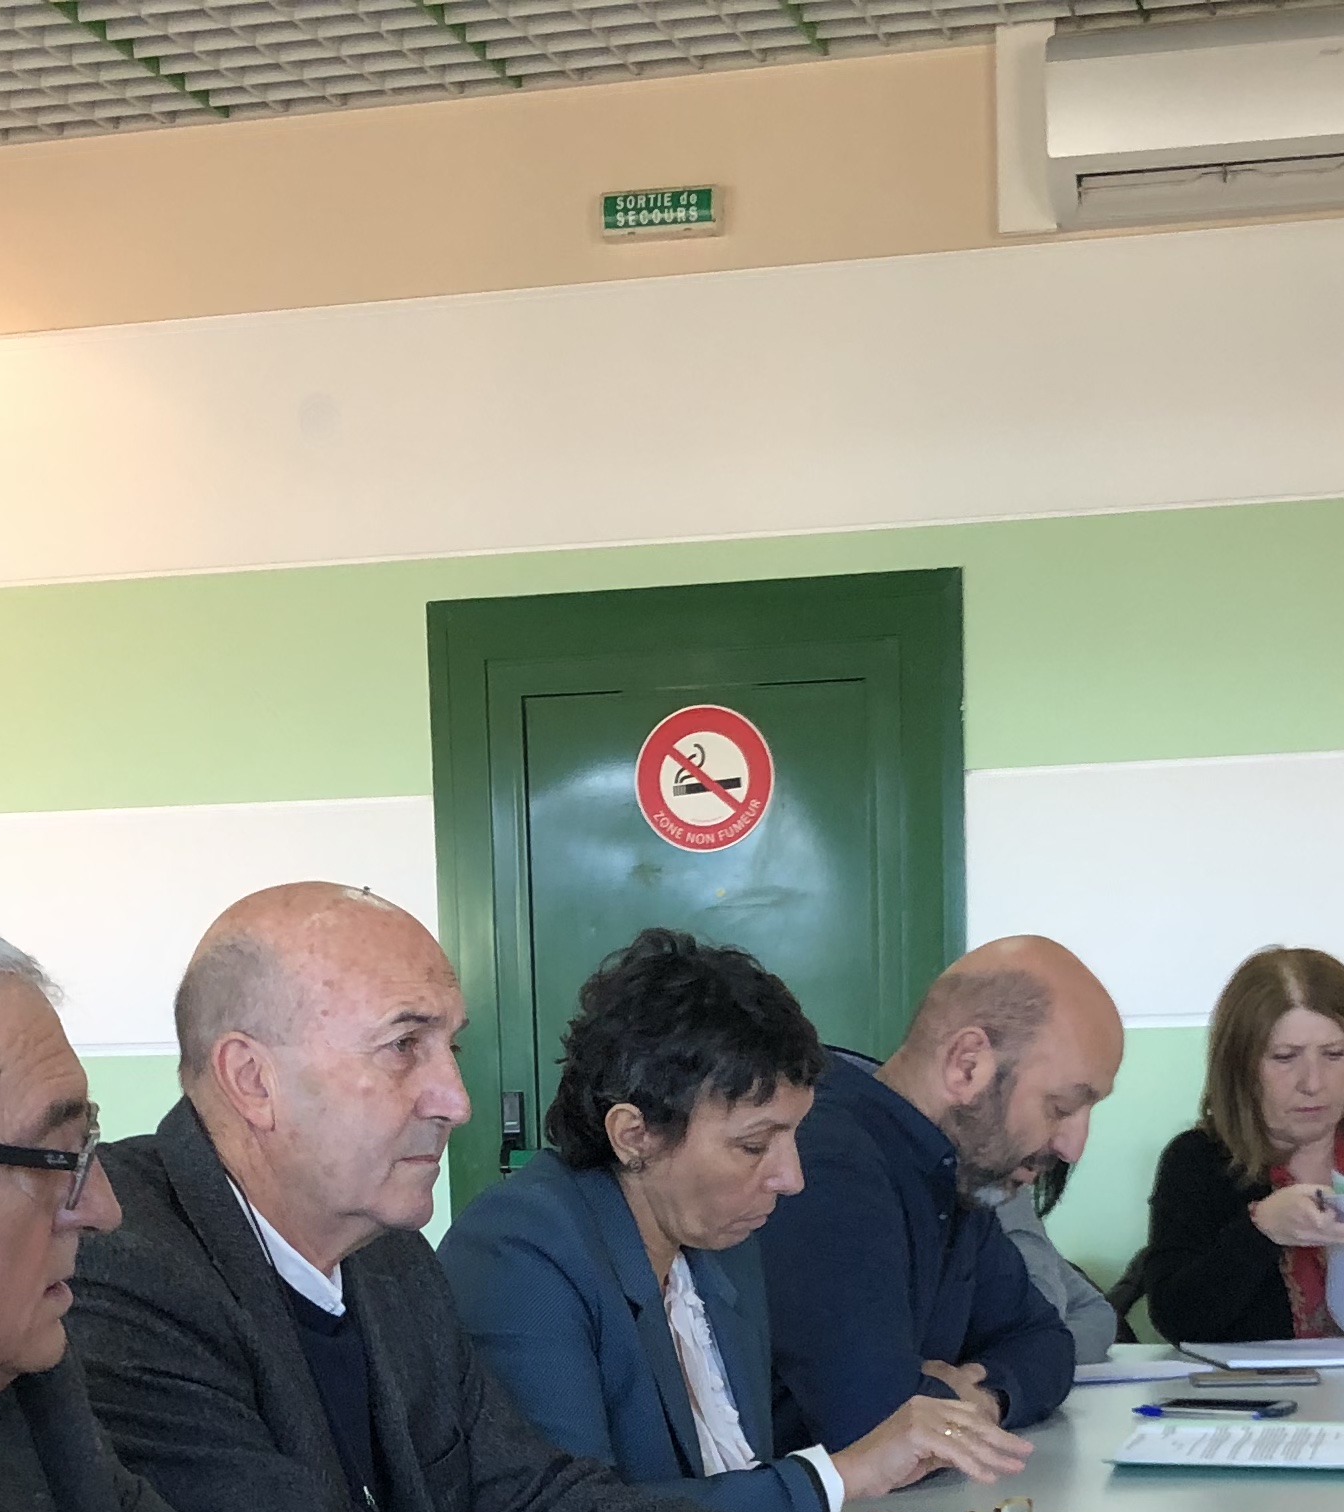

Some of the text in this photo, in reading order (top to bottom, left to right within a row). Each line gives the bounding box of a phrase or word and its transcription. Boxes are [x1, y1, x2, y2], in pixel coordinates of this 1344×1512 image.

[616, 191, 699, 210] SORTIE de
[616, 206, 699, 227] SECOURS
[652, 798, 762, 845] ZONE NON FUMEUR
